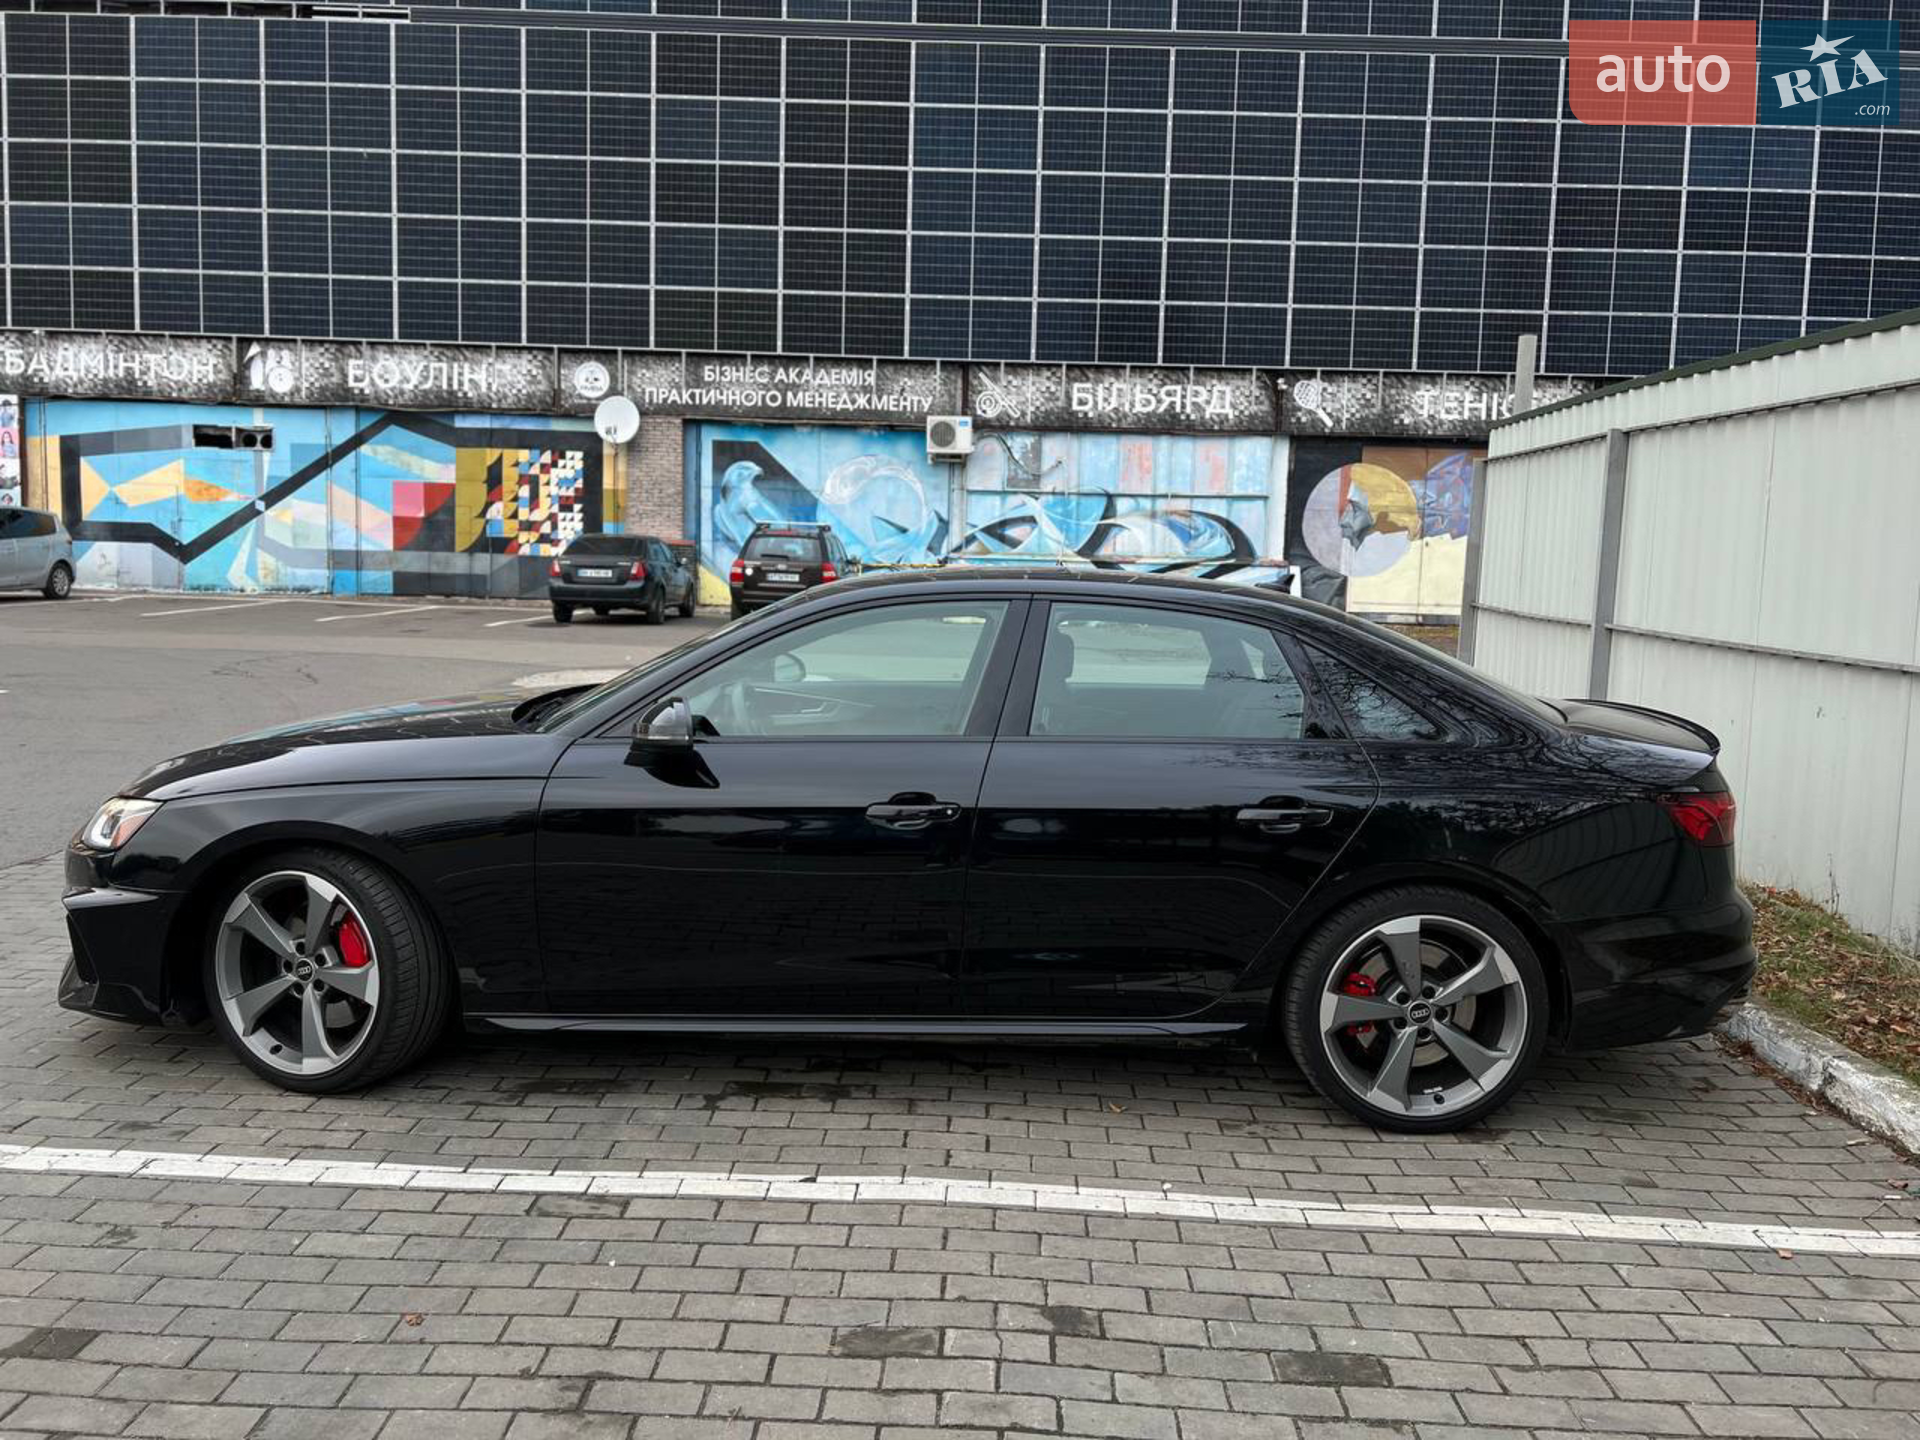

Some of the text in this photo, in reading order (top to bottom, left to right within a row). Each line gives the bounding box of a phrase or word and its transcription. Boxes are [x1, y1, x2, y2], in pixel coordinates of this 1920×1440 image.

[4, 349, 215, 384] БАДМІНТОН
[347, 358, 512, 393] БОУЛІНГ
[704, 365, 875, 387] БІЗНЕС АКАДЕМІЯ
[645, 387, 934, 413] ПРАКТИЧНОГО МЕНЕДЖМЕНТУ
[1072, 382, 1234, 419] БІЛЬЯРД
